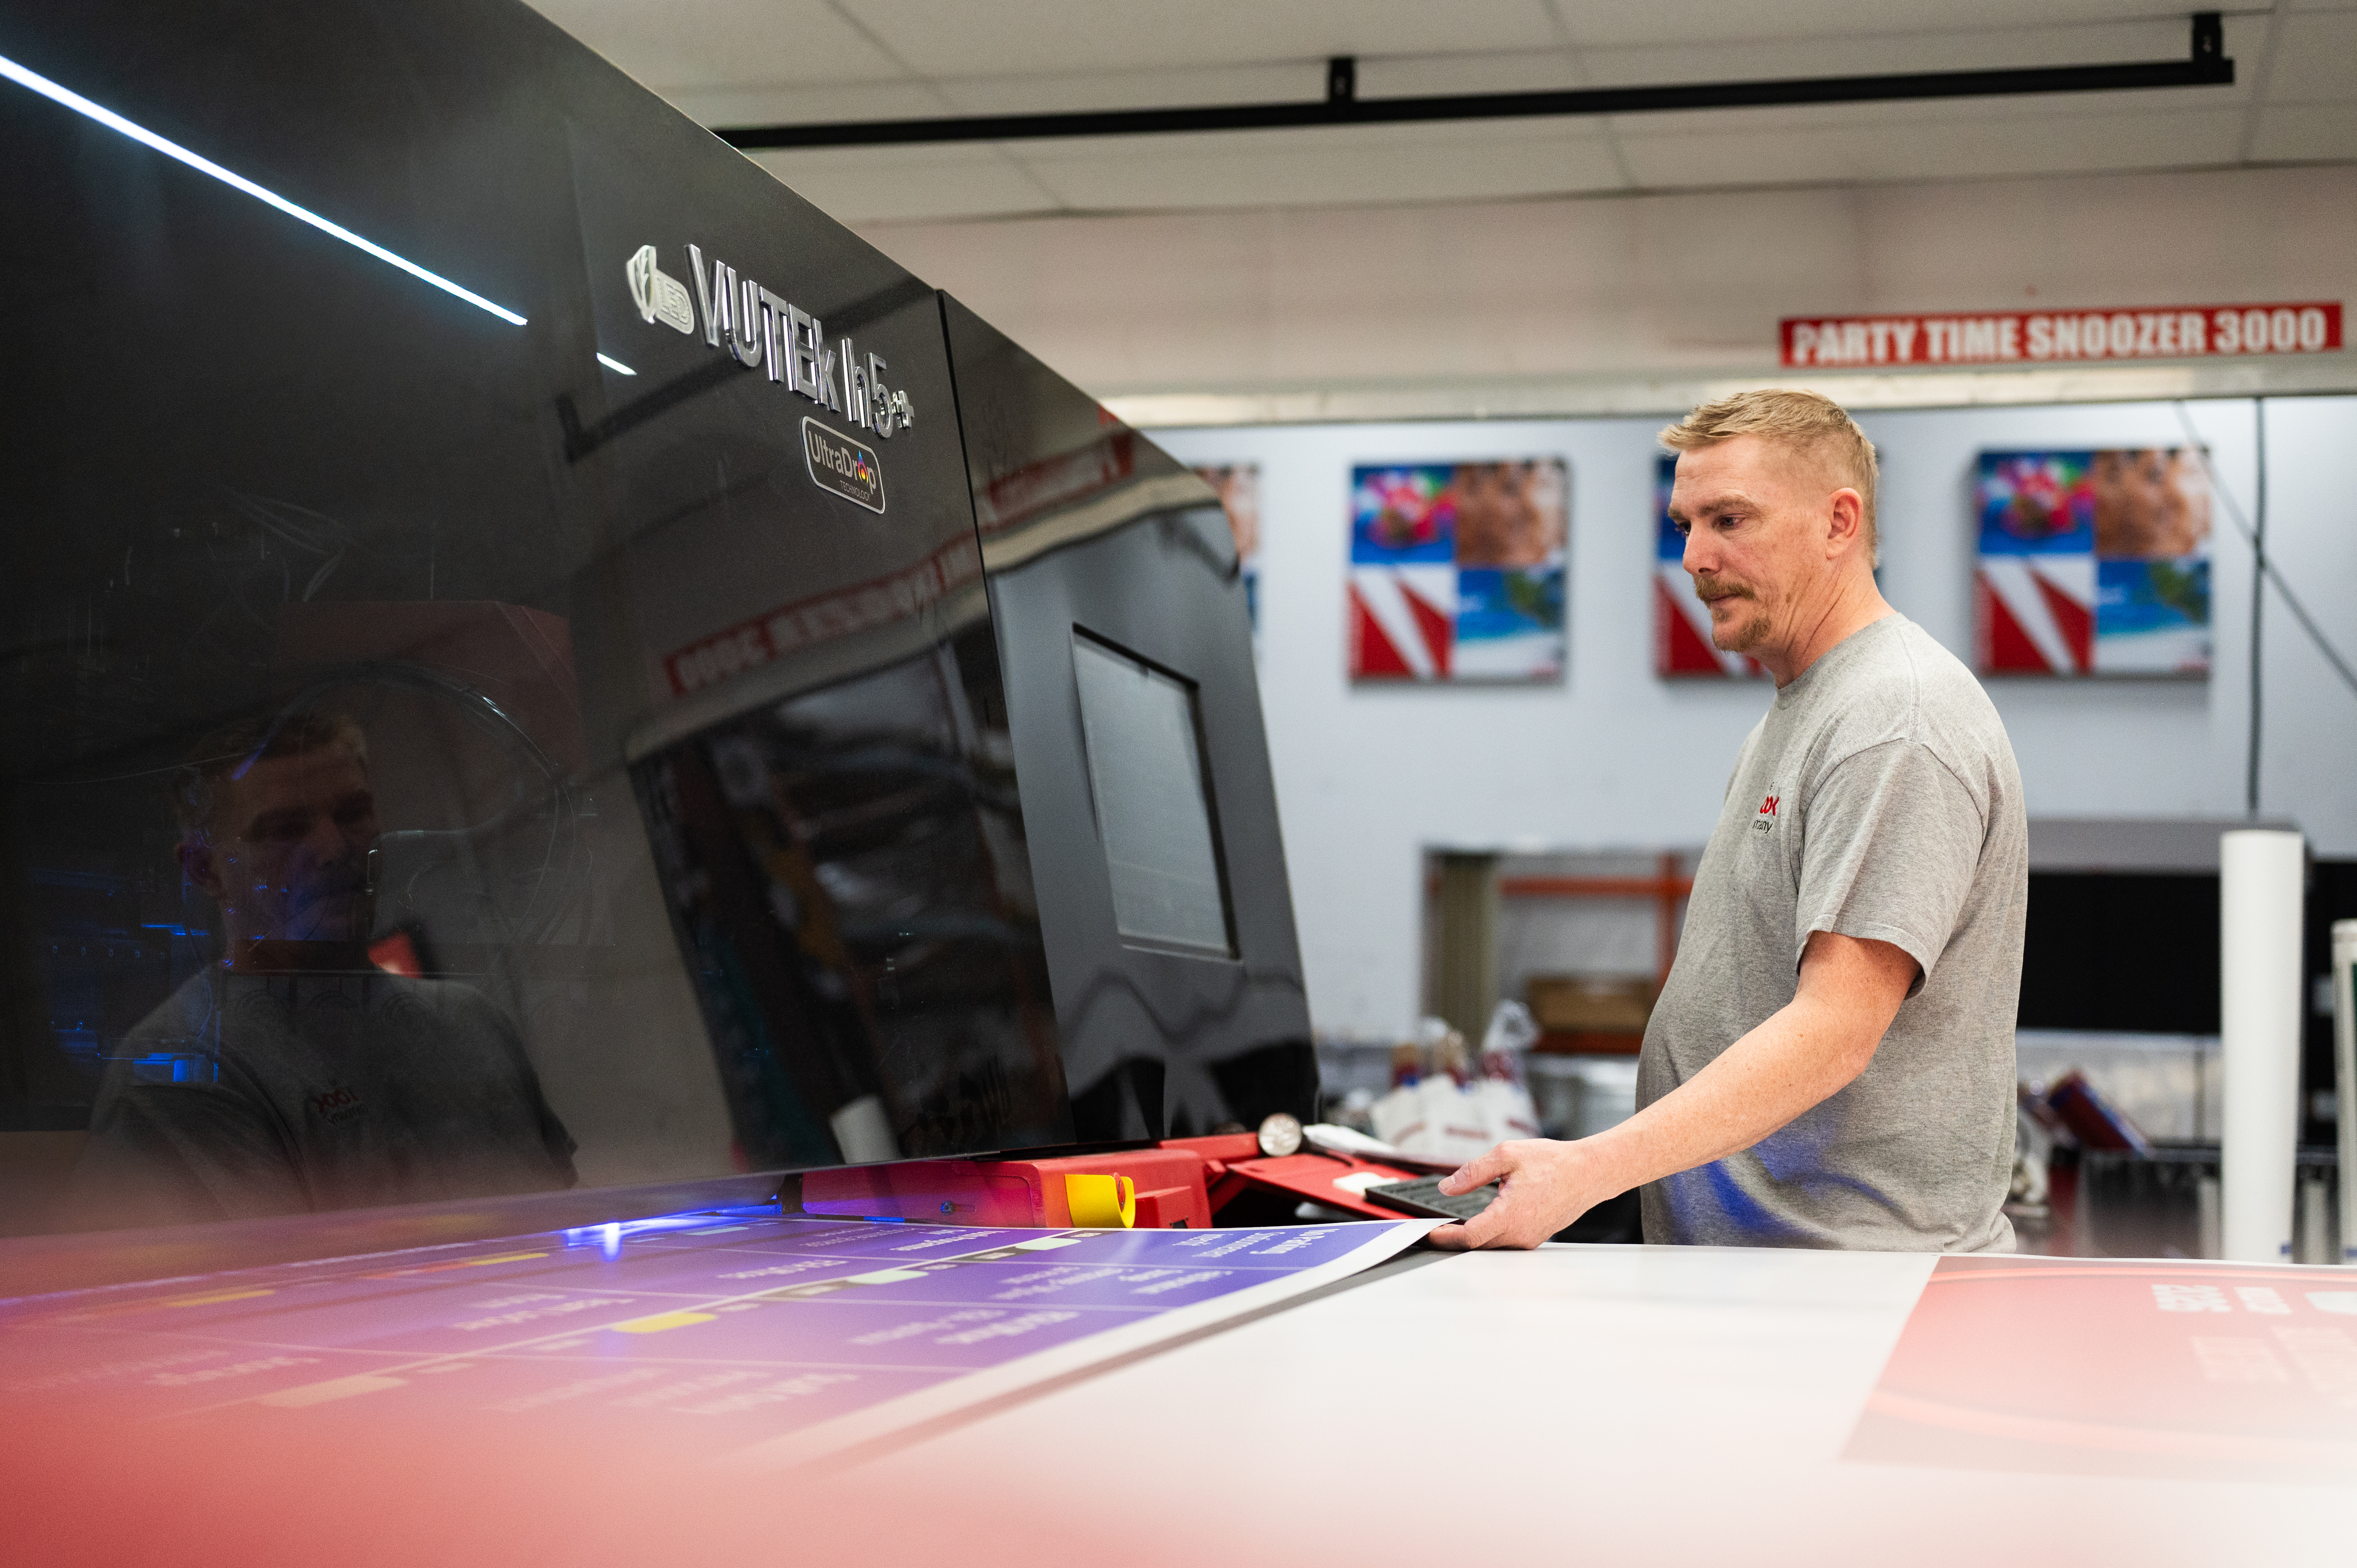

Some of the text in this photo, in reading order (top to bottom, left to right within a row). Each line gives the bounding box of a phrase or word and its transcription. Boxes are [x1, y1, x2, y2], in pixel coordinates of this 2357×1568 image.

[1792, 307, 2328, 361] PARTY TIME SNOOZER 3000
[808, 430, 876, 495] UltraDrop
[840, 480, 870, 502] TECHNOLOGY
